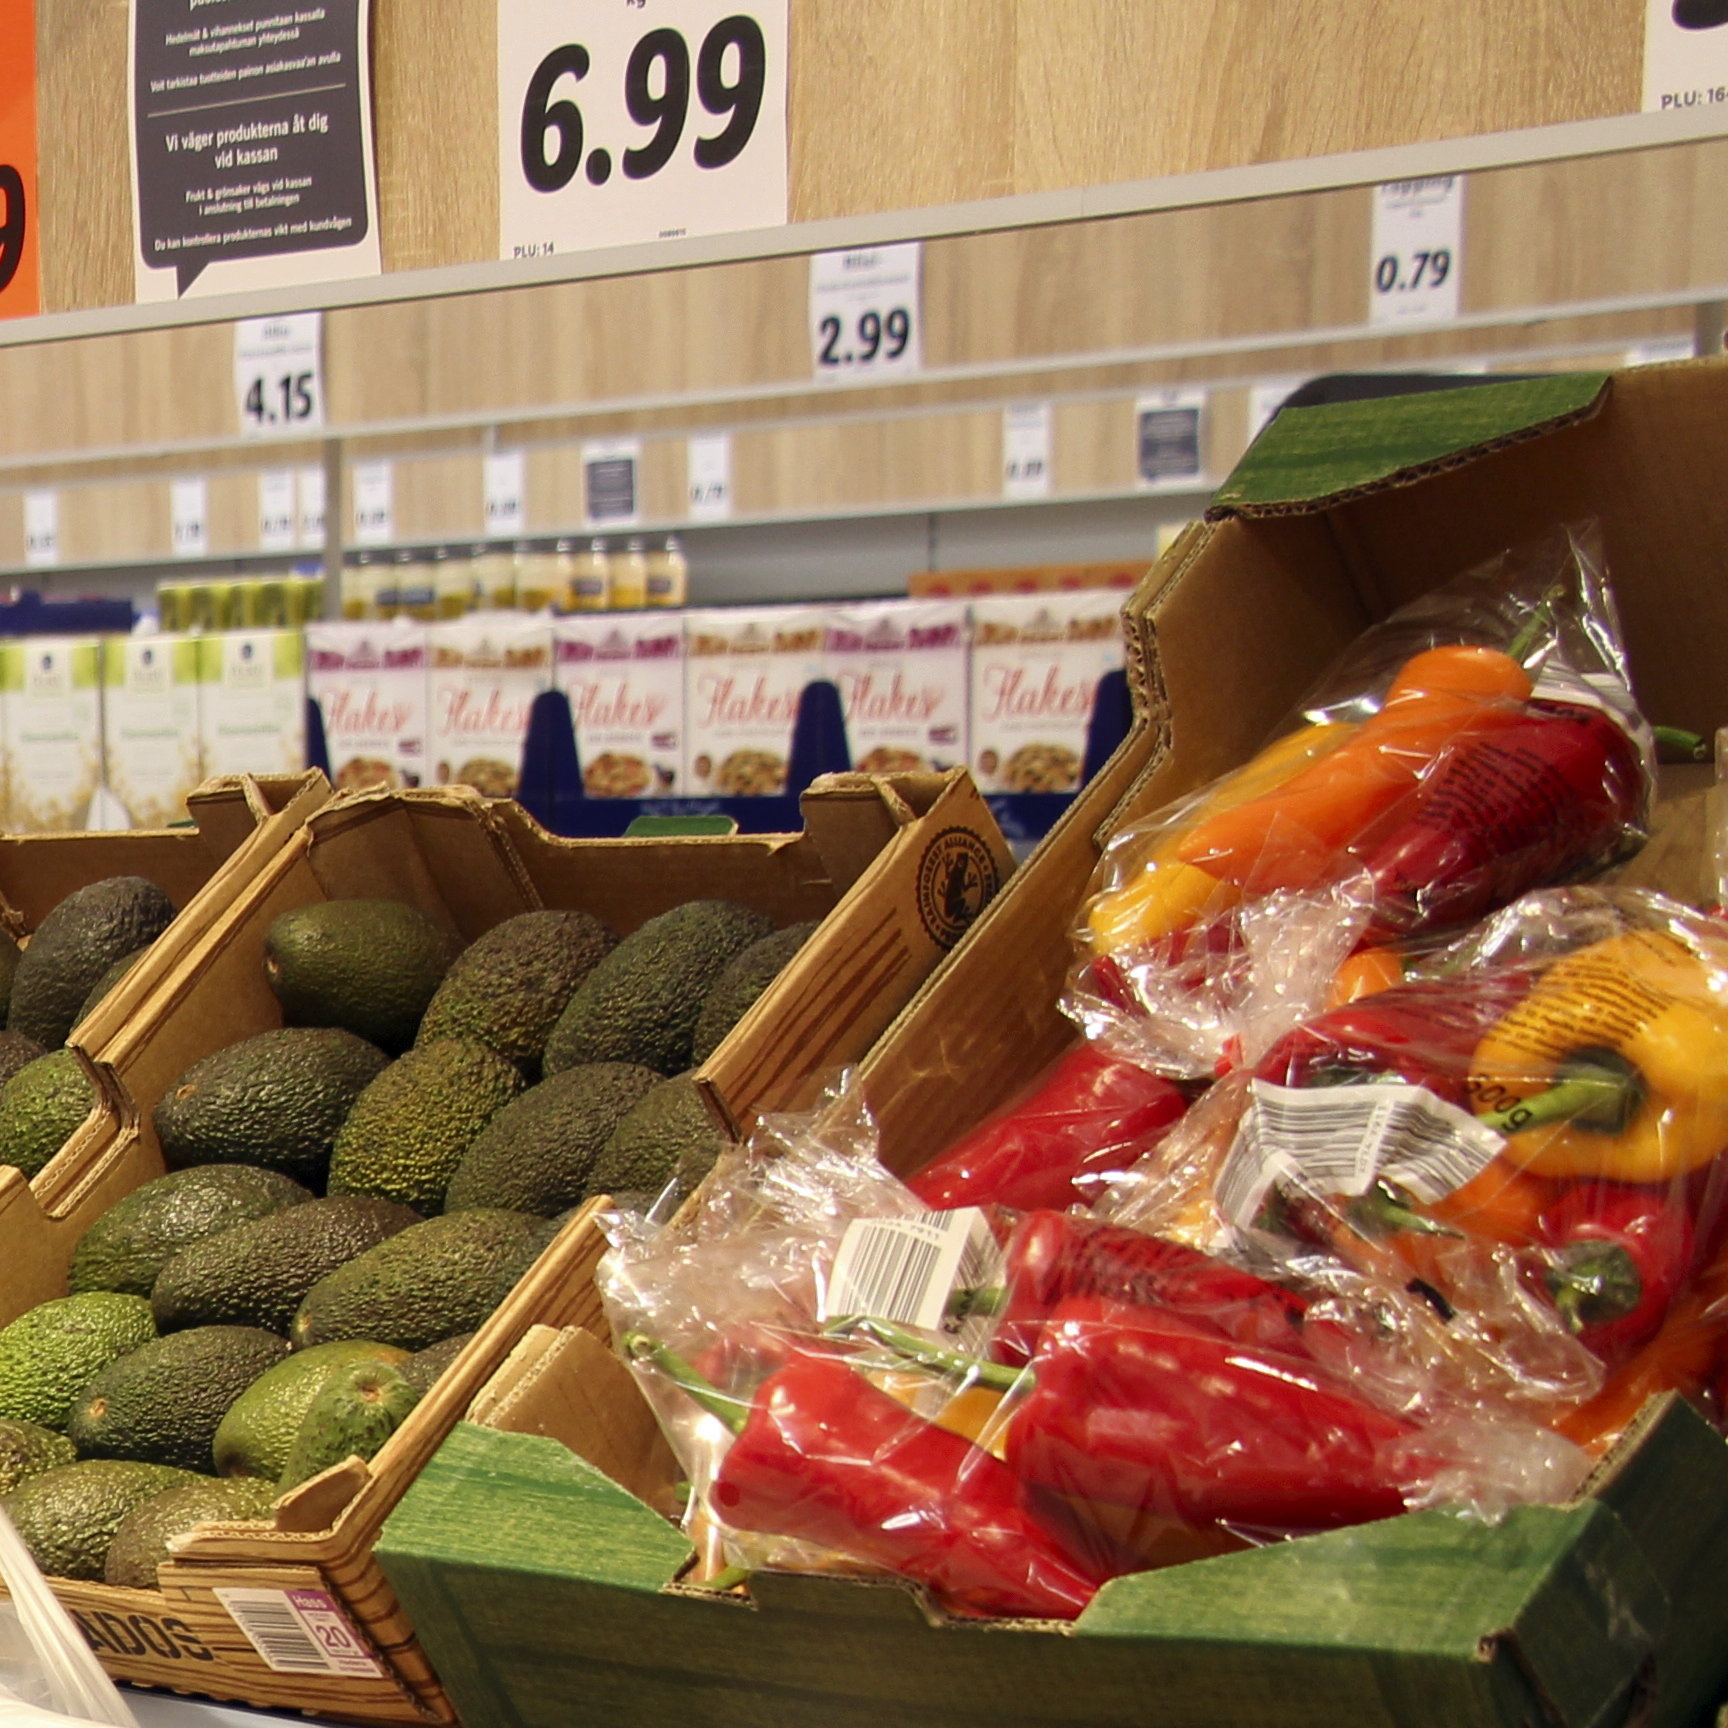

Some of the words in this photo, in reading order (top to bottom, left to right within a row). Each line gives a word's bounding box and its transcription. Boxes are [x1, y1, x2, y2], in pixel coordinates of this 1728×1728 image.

[201, 27, 209, 40] &
[294, 8, 325, 26] kassalla
[520, 14, 767, 194] 6.99
[1660, 90, 1704, 110] PLU:
[1707, 86, 1728, 105] 16
[165, 132, 179, 152] Vi
[216, 120, 288, 149] produkterna
[292, 112, 306, 134] åt
[308, 112, 329, 134] dig
[214, 149, 233, 169] vid
[236, 145, 278, 166] kassan
[185, 188, 206, 203] Frukt
[207, 187, 214, 199] &
[271, 178, 284, 191] vid
[285, 176, 312, 190] kassan
[154, 238, 166, 251] Du
[167, 235, 181, 249] kan
[182, 230, 221, 248] kontrollera
[222, 225, 272, 244] produkternas
[273, 222, 289, 236] vikt
[290, 220, 308, 235] med
[309, 215, 352, 234] kundvågen
[513, 244, 538, 258] PLU:
[541, 241, 555, 255] 14
[1376, 248, 1451, 294] 0.79
[818, 307, 910, 368] 2.99
[246, 370, 314, 425] 4.15
[293, 1593, 327, 1610] Hass
[317, 1625, 352, 1648] 20
